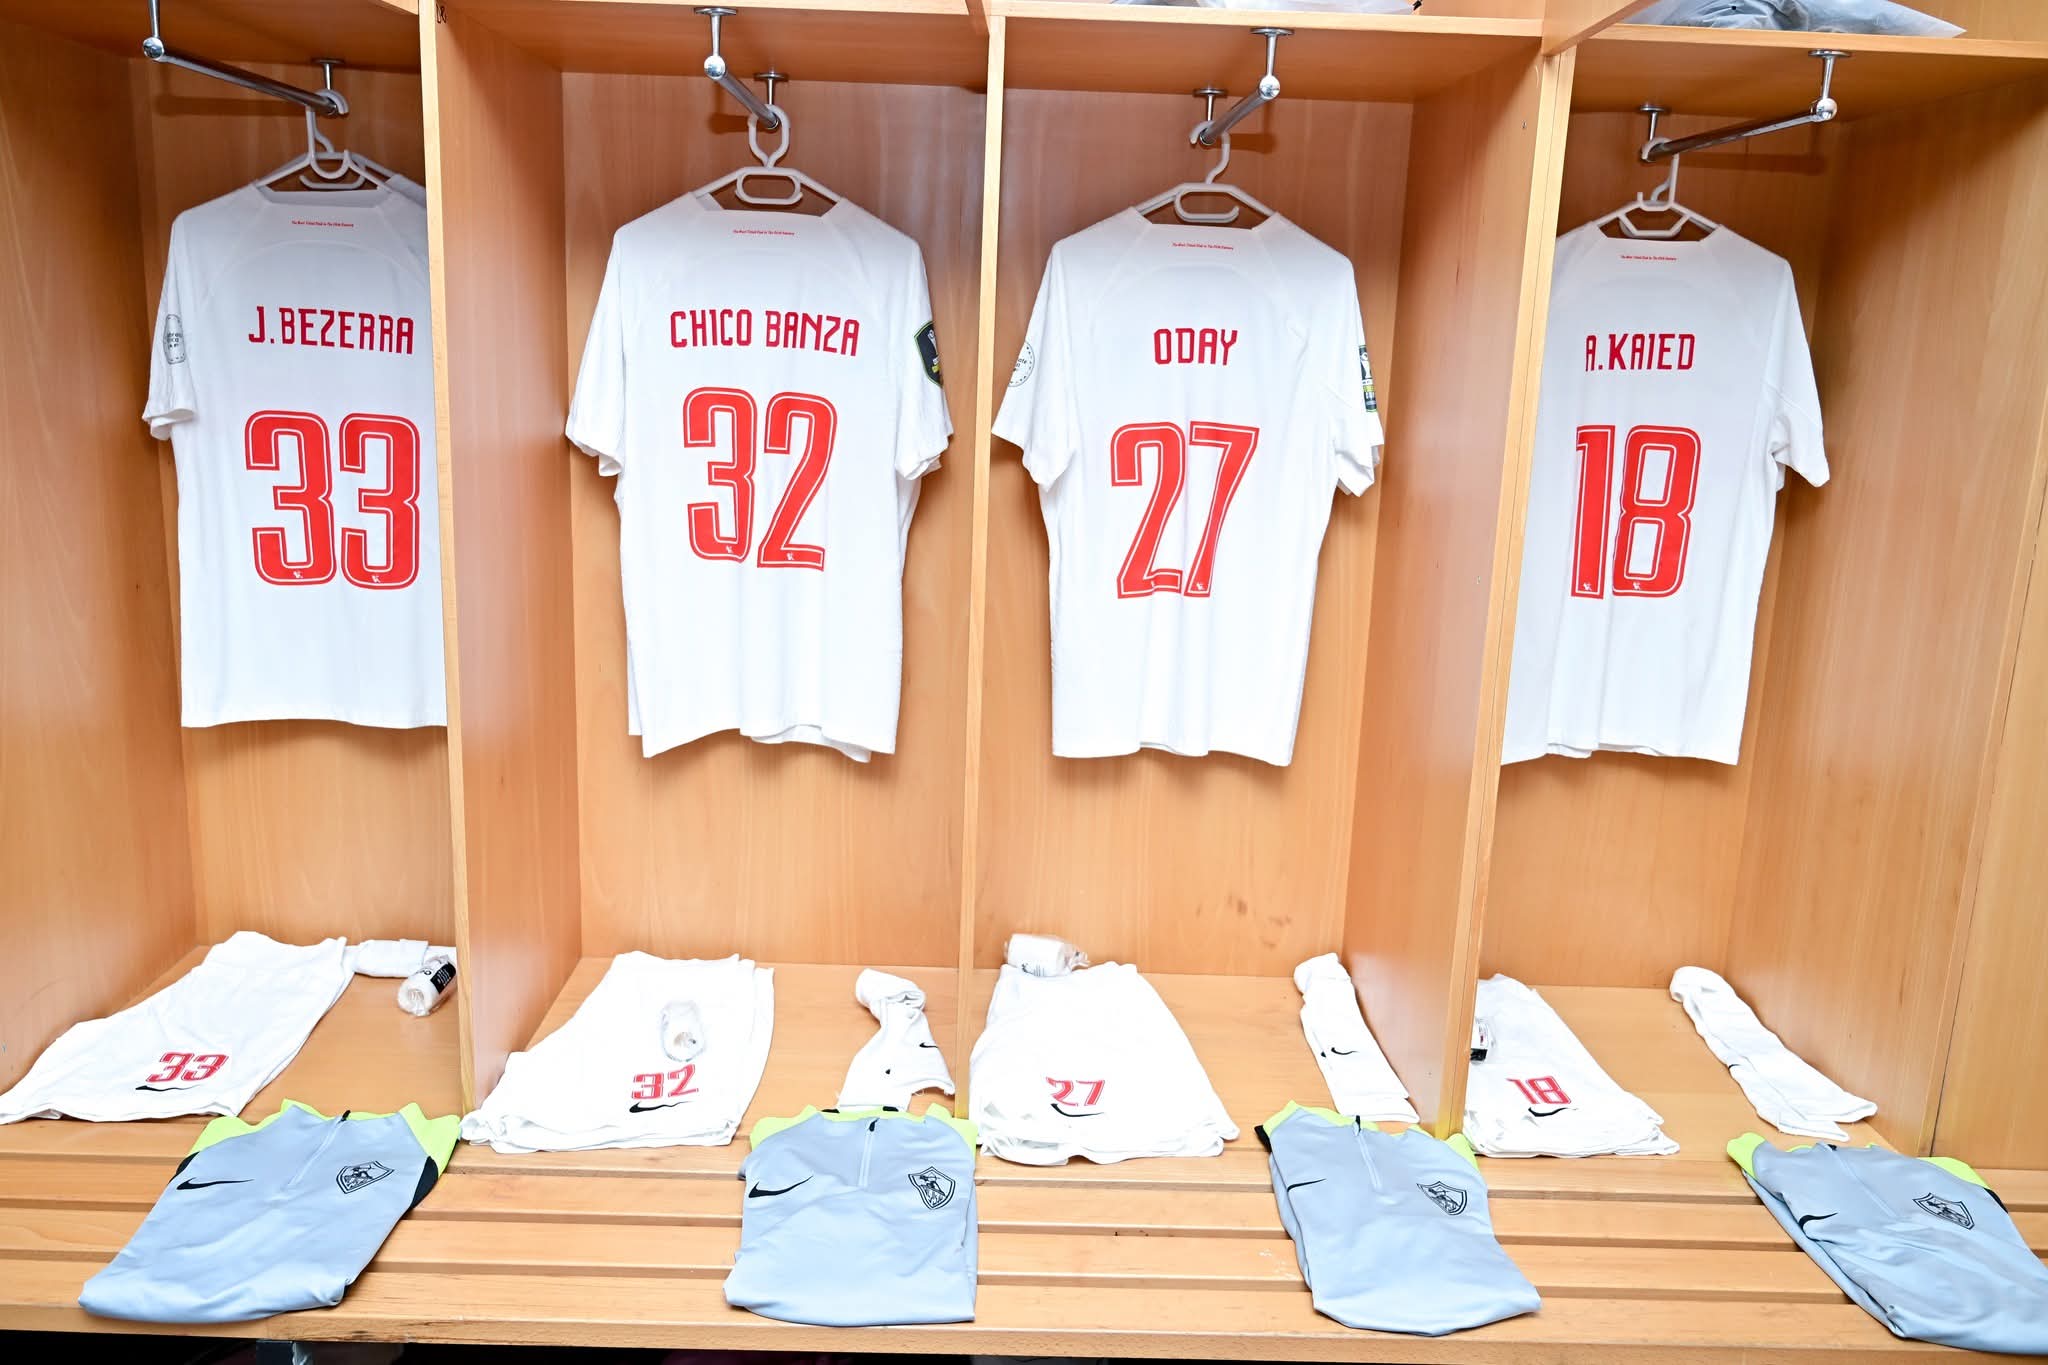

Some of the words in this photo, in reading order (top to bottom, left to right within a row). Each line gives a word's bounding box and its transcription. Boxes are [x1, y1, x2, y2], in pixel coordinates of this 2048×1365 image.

[248, 305, 415, 354] J.BEZERRA
[670, 308, 753, 349] CHICO
[765, 309, 860, 357] BANZA
[1153, 327, 1239, 366] ODAY
[1585, 332, 1696, 371] A.KAIED
[243, 409, 421, 591] 33
[682, 386, 838, 572] 32
[1109, 420, 1261, 600] 27
[1570, 423, 1702, 601] 18
[145, 1051, 229, 1084] 33
[632, 1063, 699, 1100] 32
[1047, 1077, 1105, 1106] 27
[1505, 1075, 1570, 1105] 18
